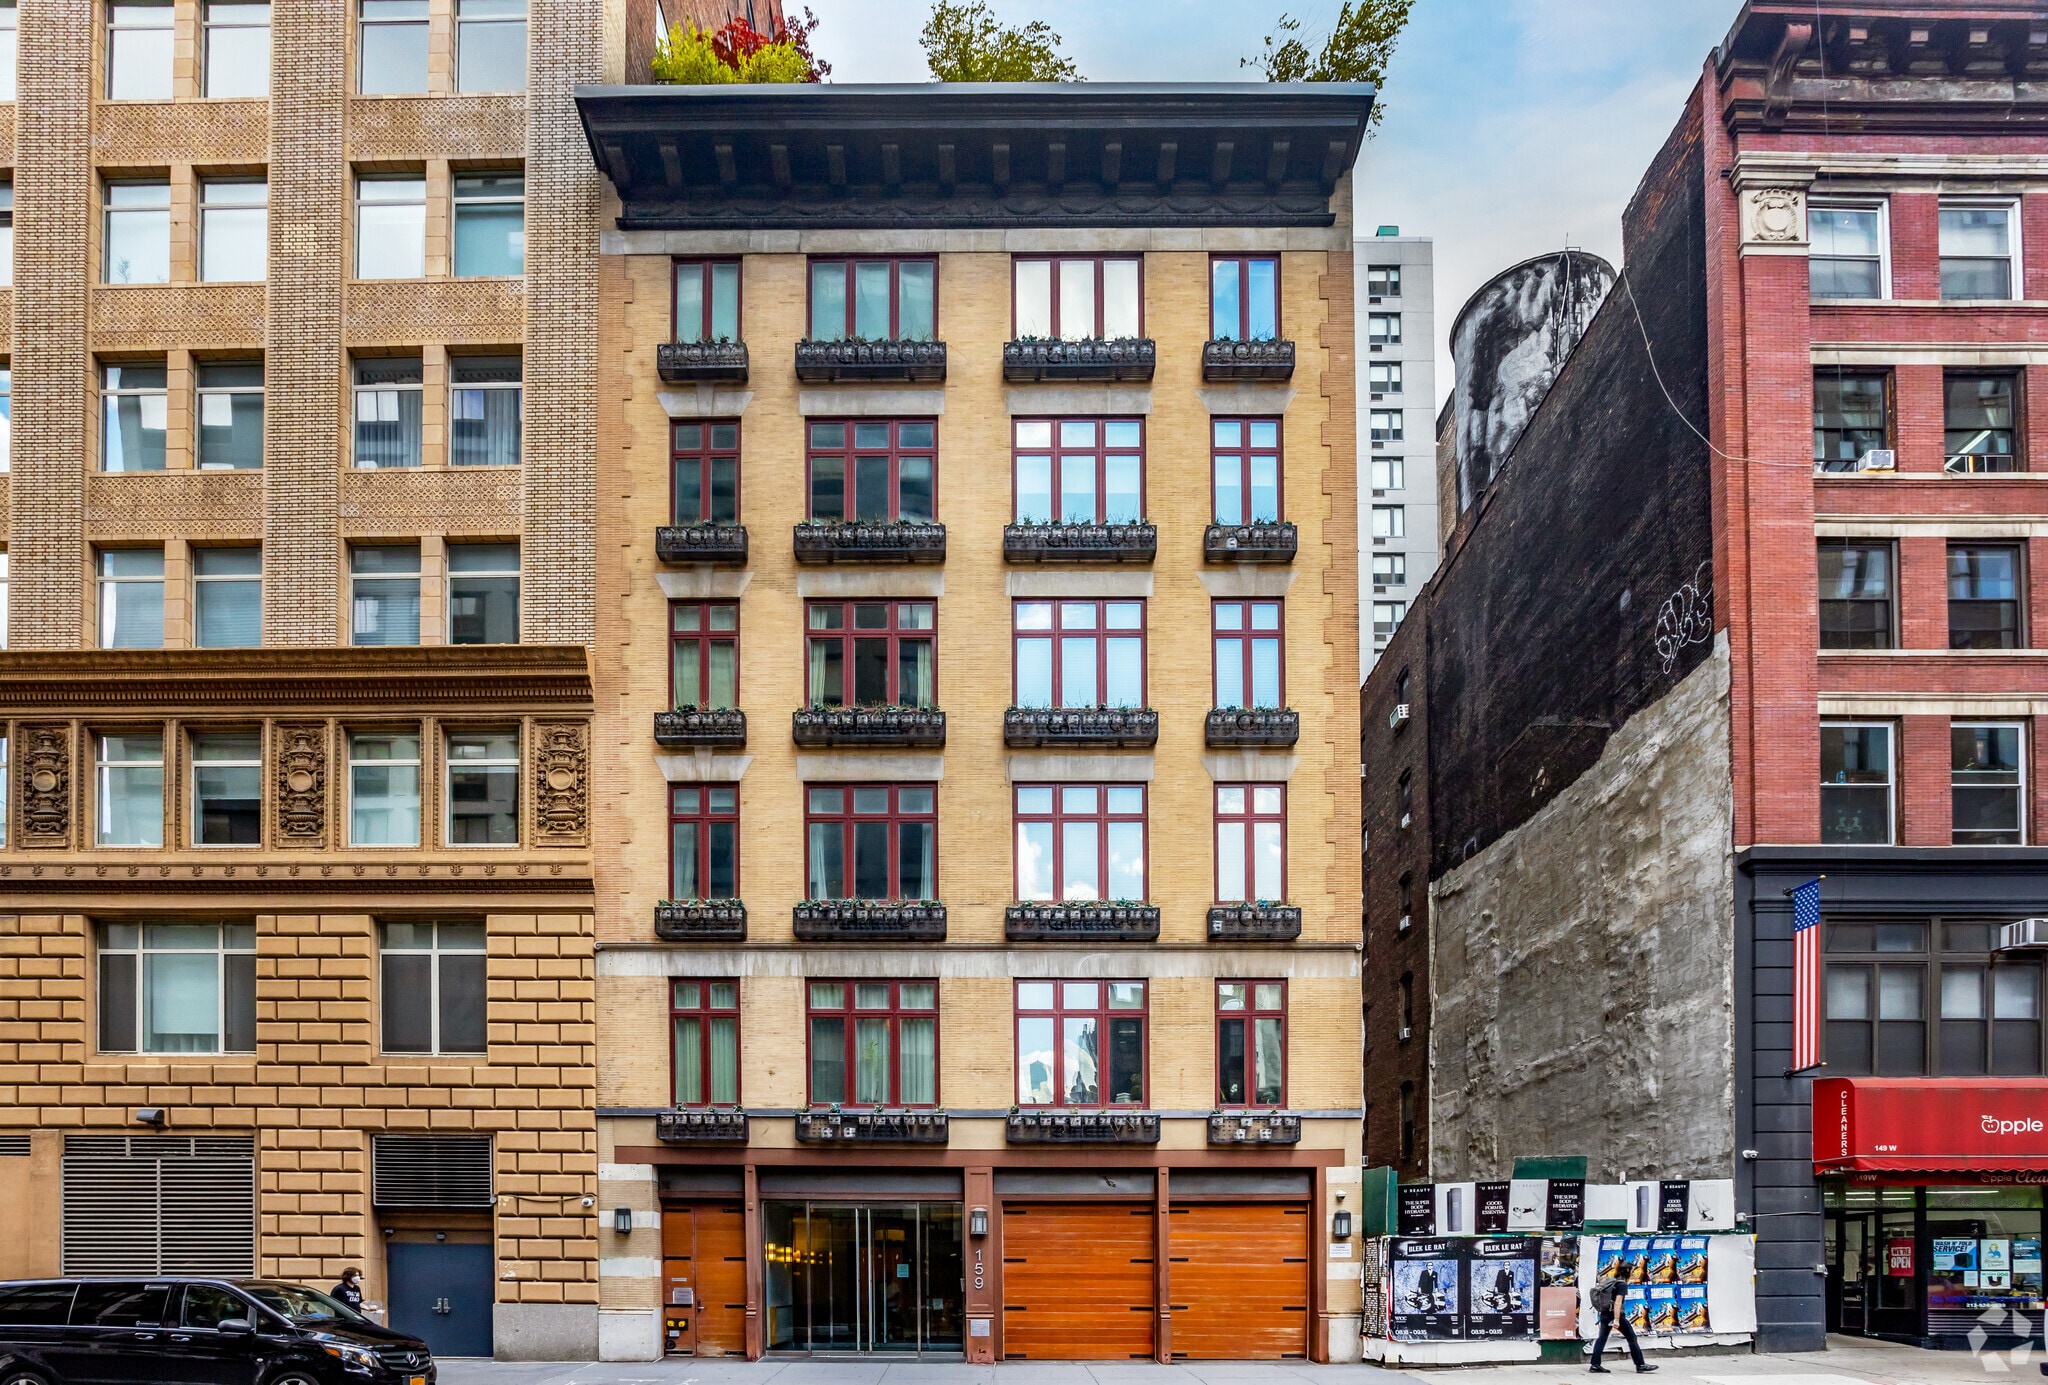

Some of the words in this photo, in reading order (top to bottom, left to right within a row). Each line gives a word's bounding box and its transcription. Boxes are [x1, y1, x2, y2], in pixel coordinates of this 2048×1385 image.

[1840, 1091, 1848, 1156] CLEANERS
[2015, 1171, 2048, 1183] Clea
[1408, 1245, 1423, 1253] BLEK
[1484, 1244, 1500, 1252] BLEK
[1891, 1257, 1911, 1268] OPEN
[974, 1249, 984, 1289] 159
